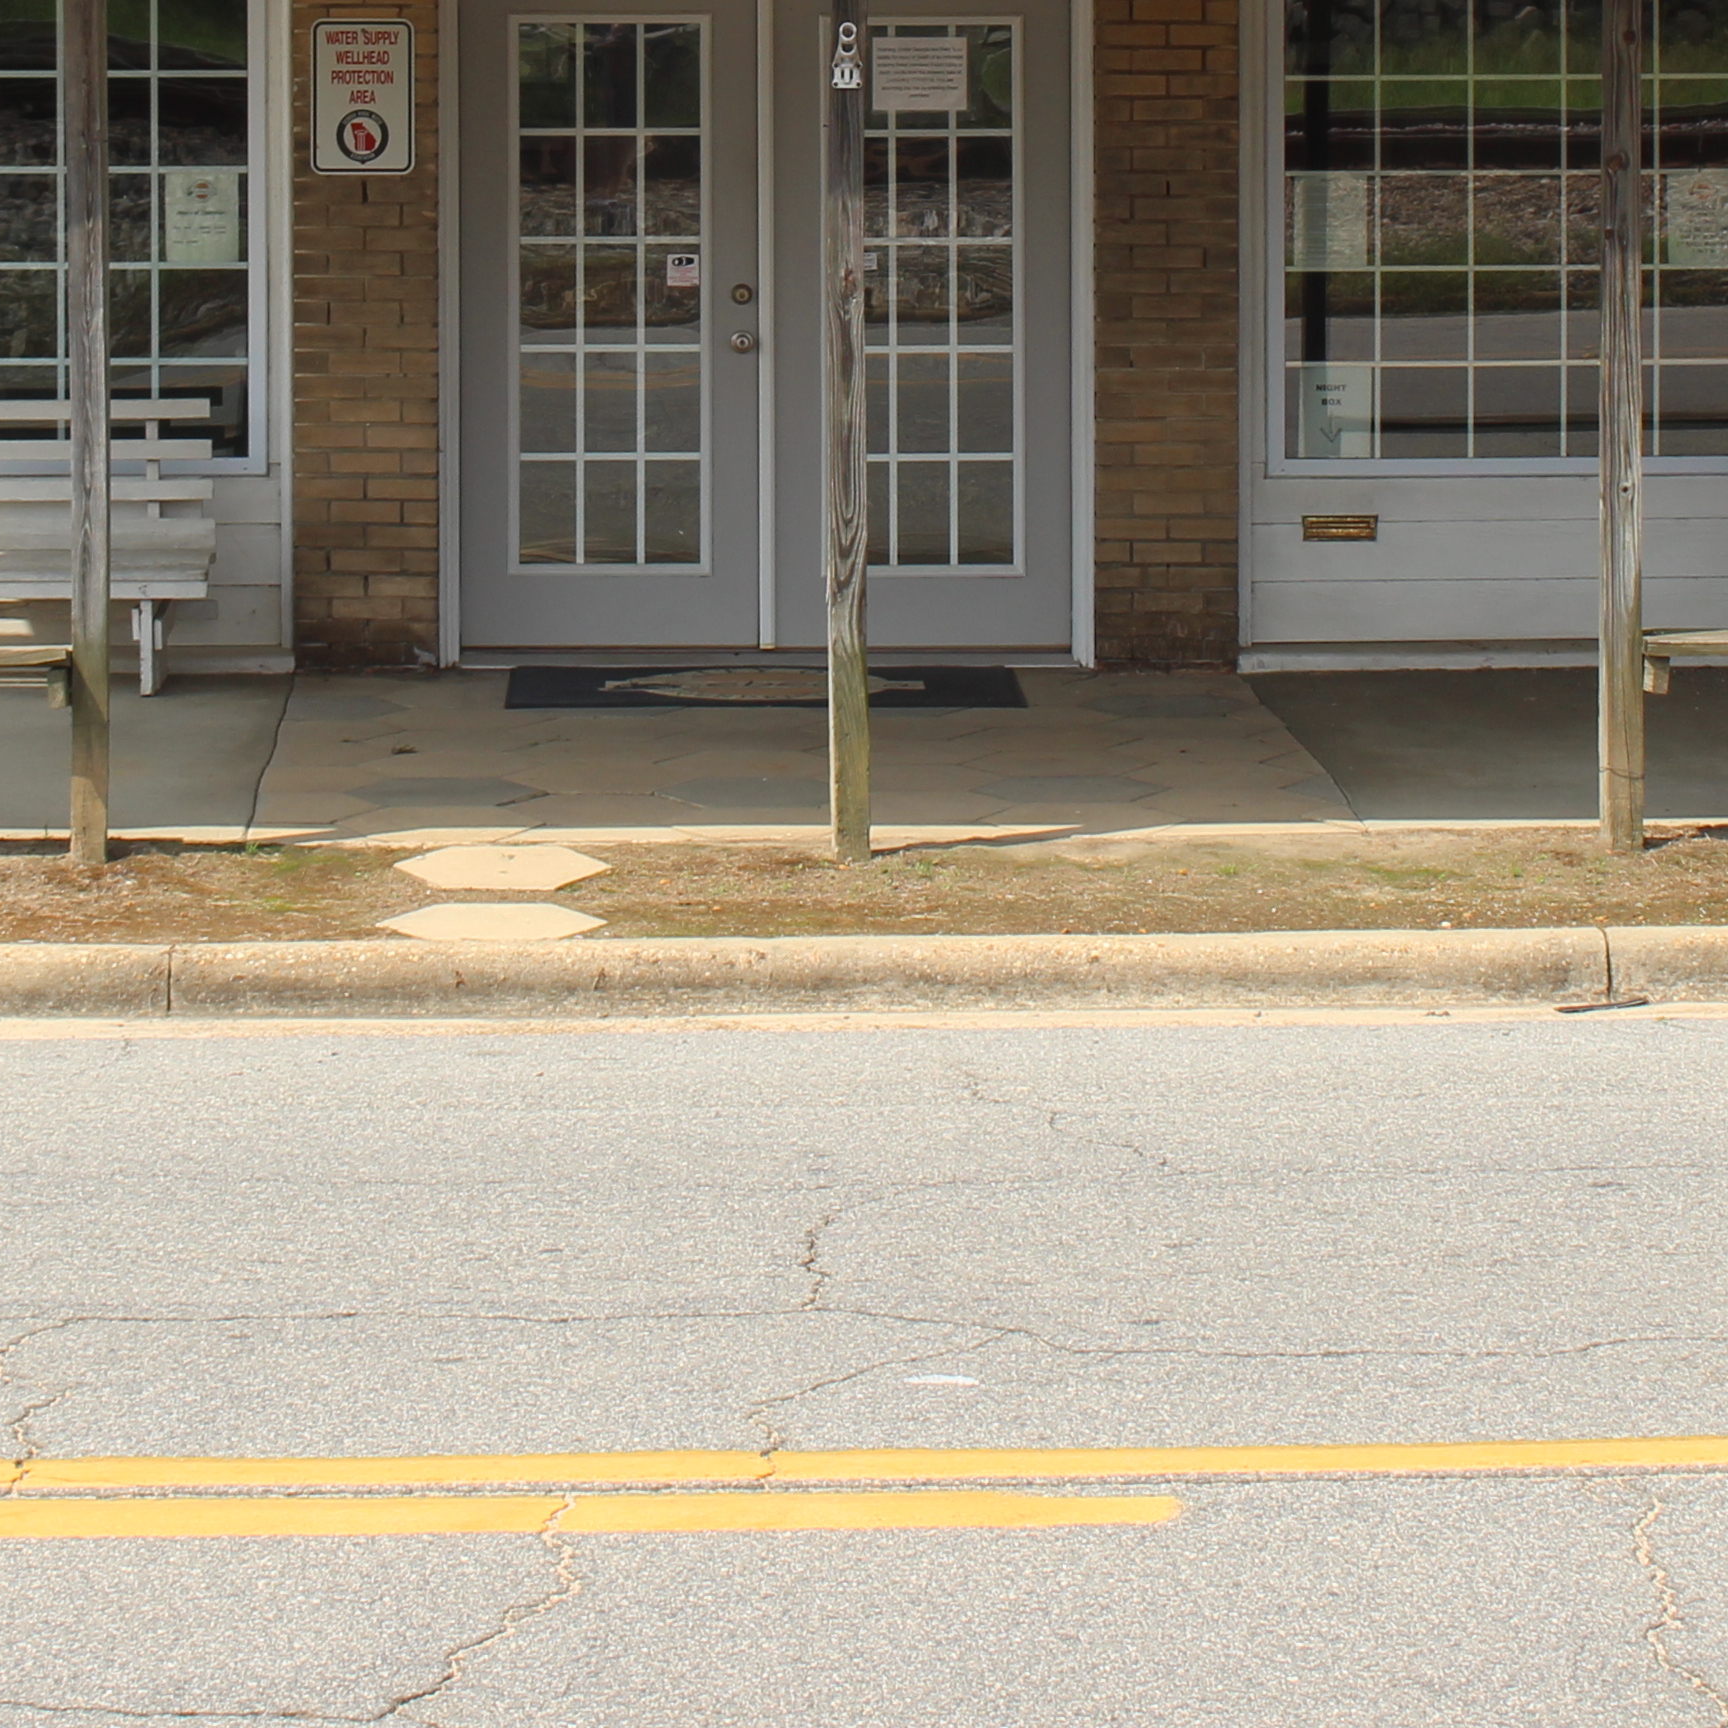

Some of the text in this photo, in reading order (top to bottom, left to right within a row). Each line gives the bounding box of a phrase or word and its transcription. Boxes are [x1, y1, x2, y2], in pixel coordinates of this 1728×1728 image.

[325, 30, 400, 46] WATER SUPPLY
[335, 50, 390, 65] WELLHEAD
[330, 69, 394, 85] PROTECTION
[348, 89, 377, 105] AREA
[1315, 384, 1347, 392] NIGHT
[1321, 398, 1342, 406] BOX
